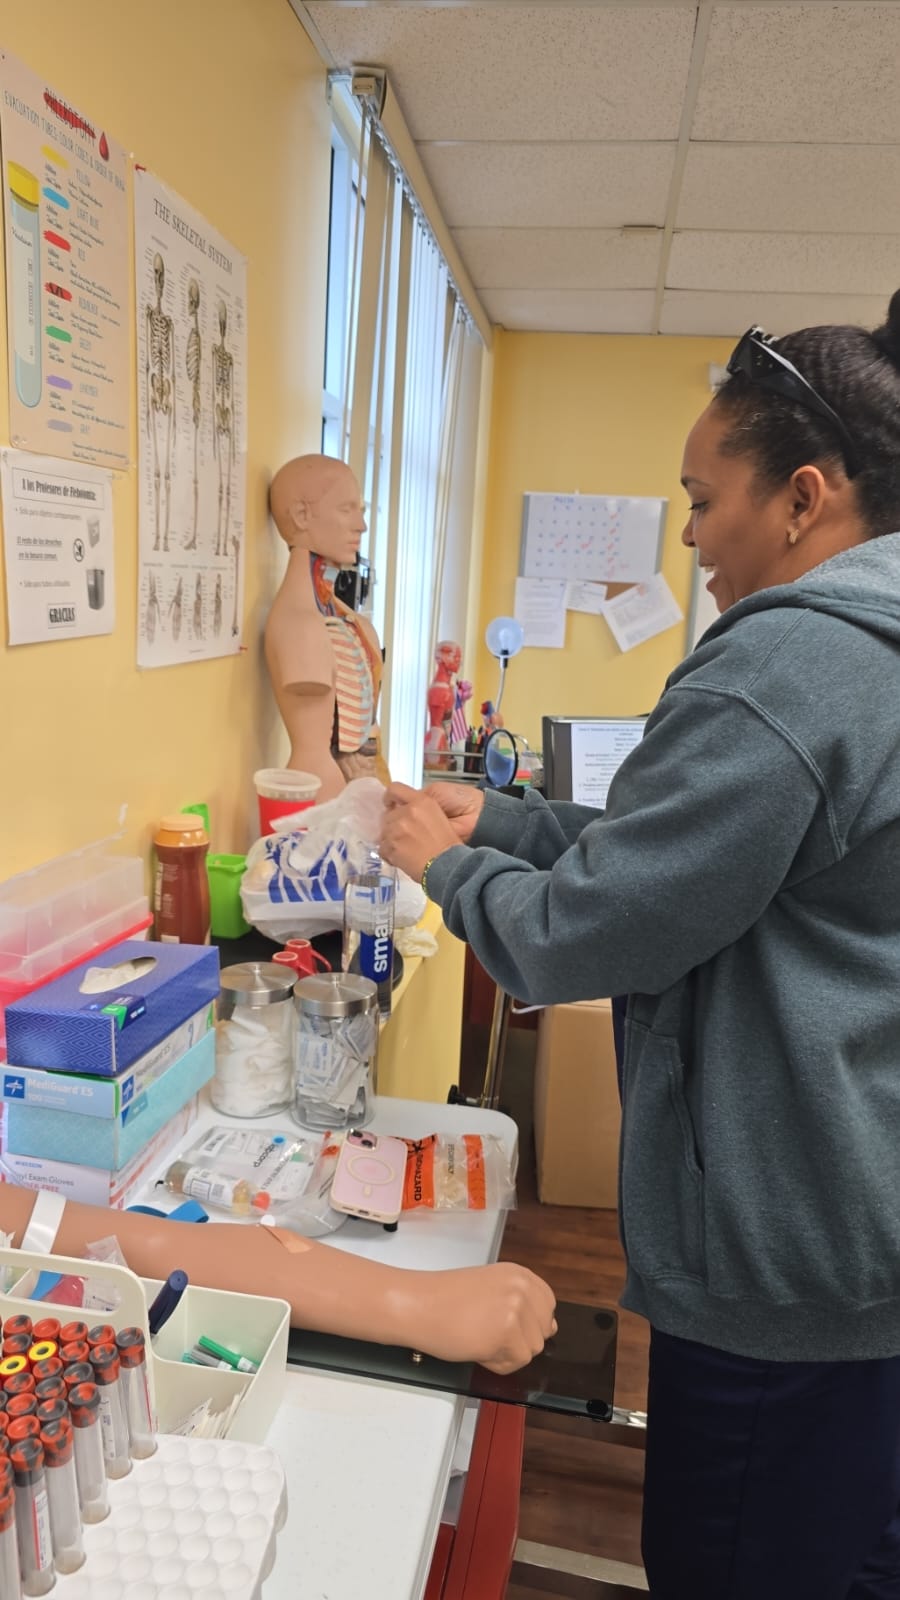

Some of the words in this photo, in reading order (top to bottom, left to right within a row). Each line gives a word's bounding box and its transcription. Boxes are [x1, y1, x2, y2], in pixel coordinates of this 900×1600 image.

[153, 198, 170, 225] THE
[172, 214, 207, 255] SKELETAL
[207, 244, 233, 275] SYSTEM
[49, 607, 75, 623] GRACIAS
[373, 907, 388, 973] smart
[28, 1078, 79, 1095] MediGuard
[80, 1086, 94, 1097] ES
[28, 1173, 48, 1182] Exam
[48, 1176, 75, 1187] Gloves
